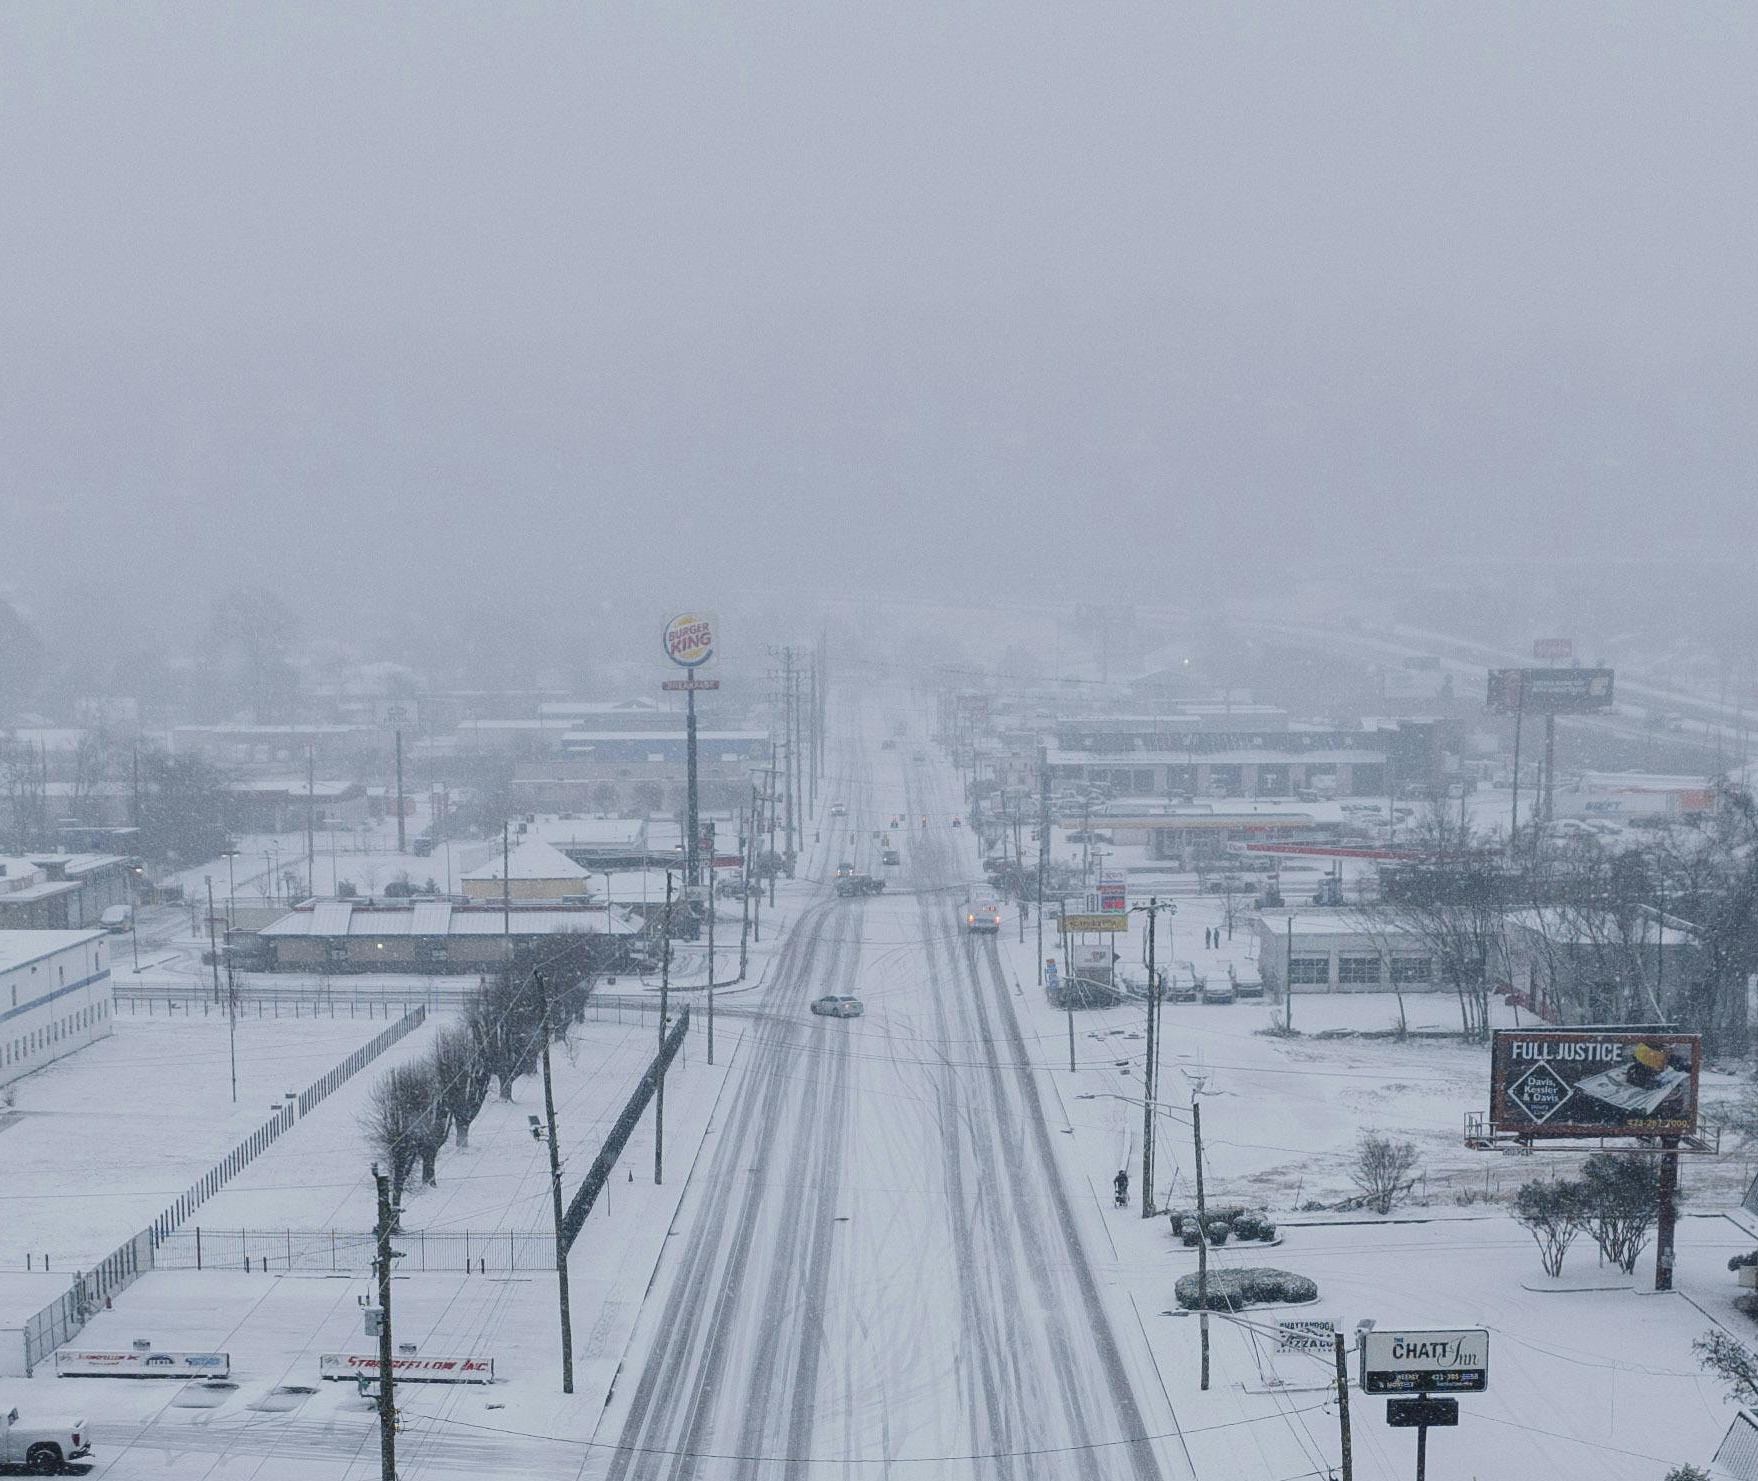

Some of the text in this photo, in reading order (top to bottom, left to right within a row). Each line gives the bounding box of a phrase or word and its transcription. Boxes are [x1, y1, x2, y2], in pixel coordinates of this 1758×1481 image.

[668, 622, 709, 641] BURGER
[670, 632, 711, 656] KING
[1511, 1041, 1623, 1061] FULL JUSTICE
[1524, 1086, 1559, 1094] Kessler
[1528, 1077, 1556, 1087] Davis,
[1533, 1093, 1559, 1102] Davis
[1392, 1335, 1479, 1368] CHATT Inn
